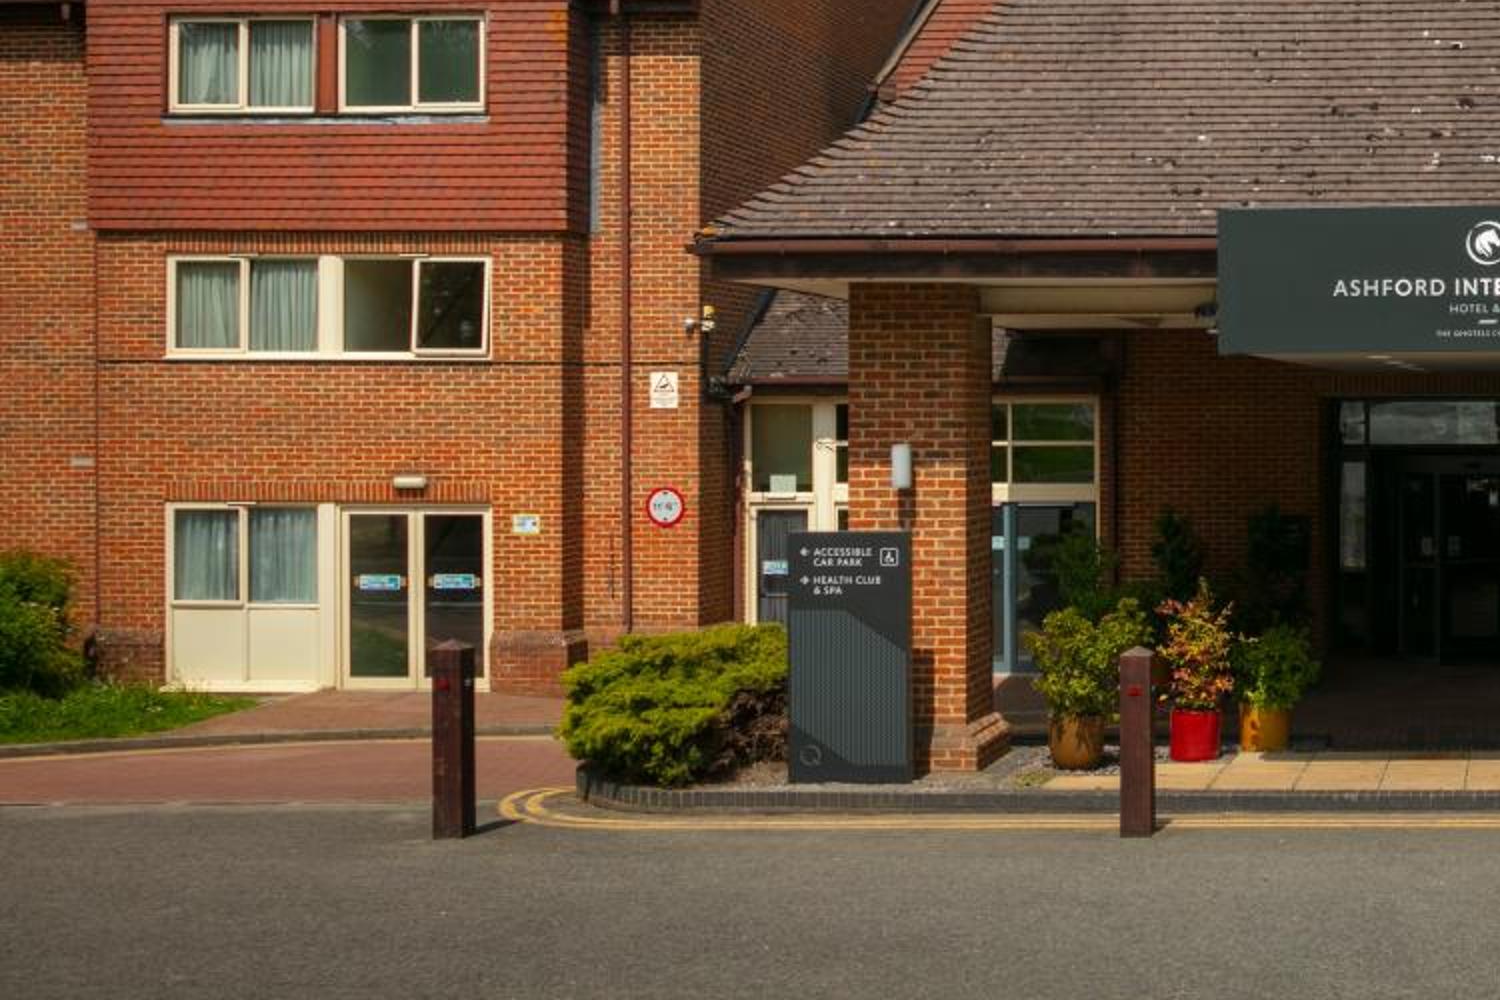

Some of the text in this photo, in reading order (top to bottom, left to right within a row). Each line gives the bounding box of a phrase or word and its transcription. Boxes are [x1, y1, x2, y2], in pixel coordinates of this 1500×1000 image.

[1333, 278, 1446, 297] ASHFORD
[1449, 303, 1488, 314] HOTEL
[1492, 303, 1500, 313] &
[813, 547, 873, 557] ACCESSIBLE
[813, 557, 863, 567] CAR PARK
[813, 575, 881, 585] HEALTH CLUB
[813, 586, 842, 595] & SPA
